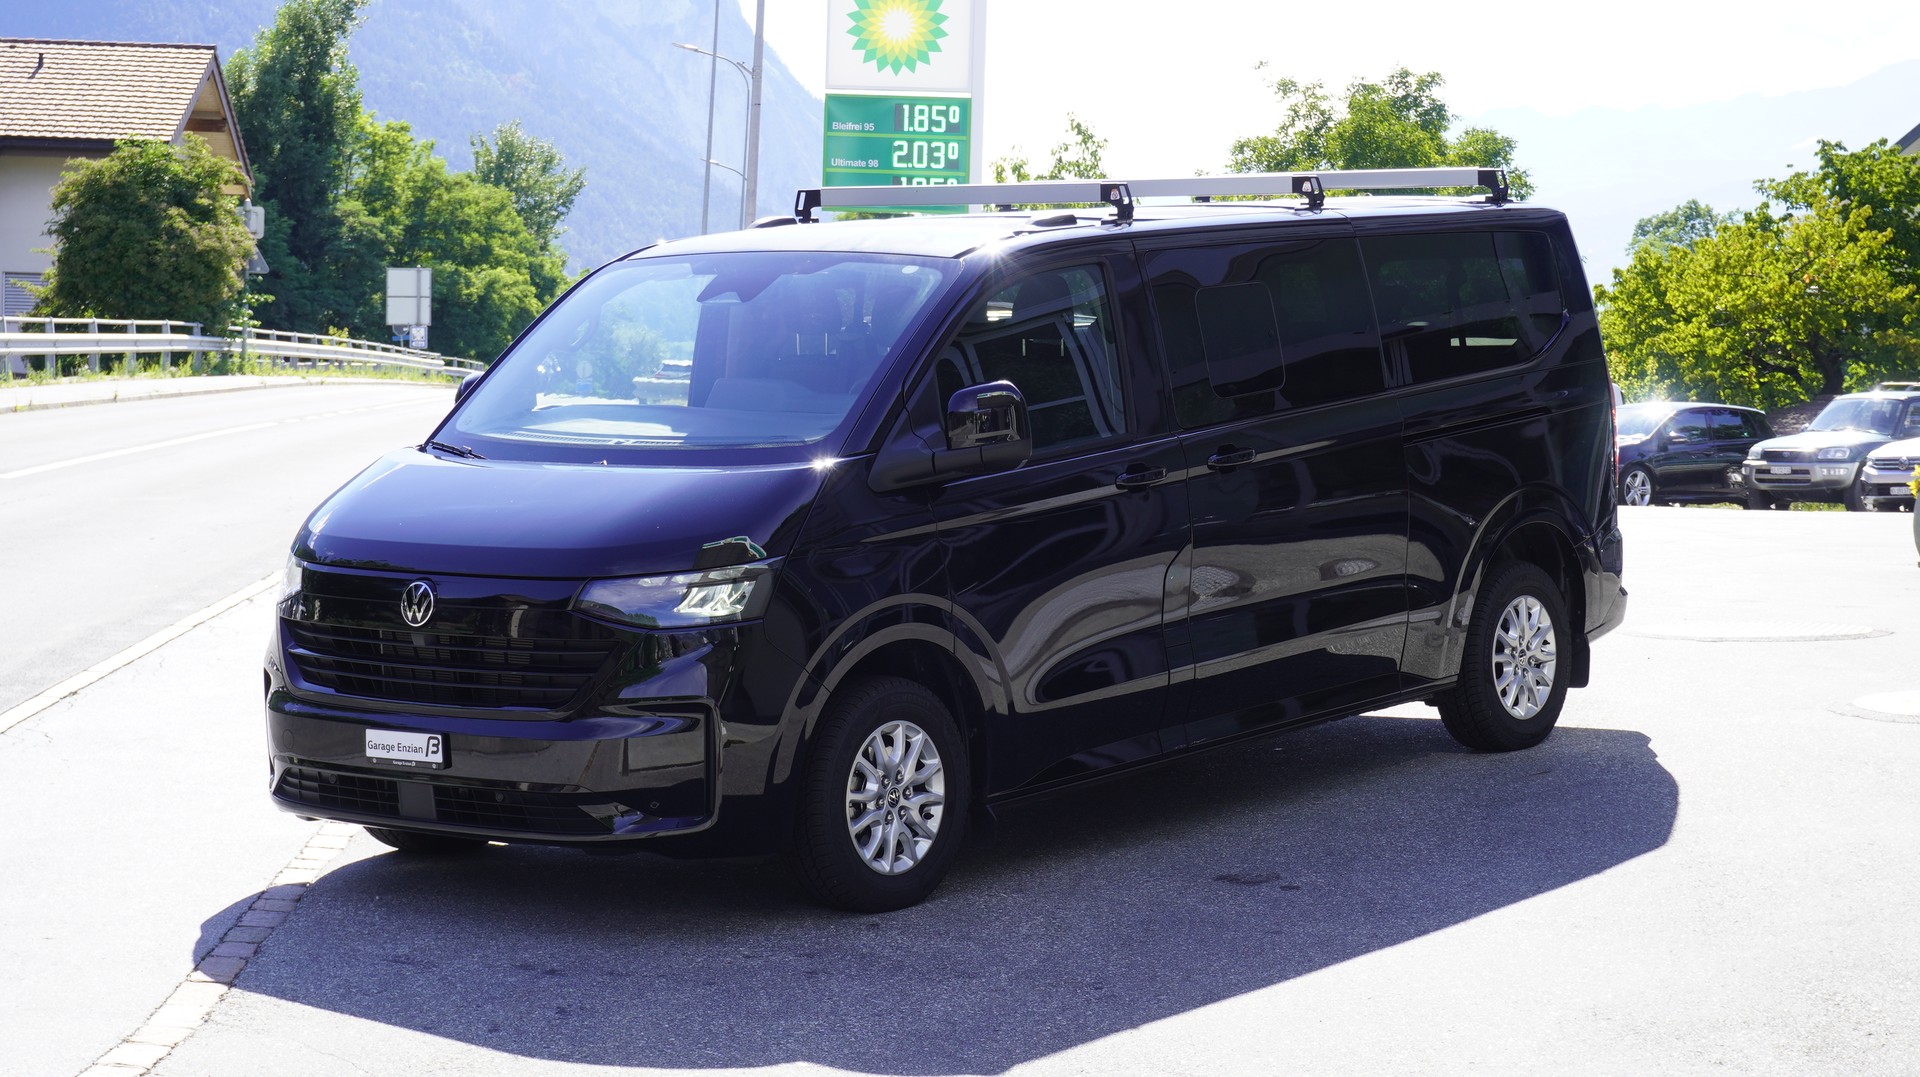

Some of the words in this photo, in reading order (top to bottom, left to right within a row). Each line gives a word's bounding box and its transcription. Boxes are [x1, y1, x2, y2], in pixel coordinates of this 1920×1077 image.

[832, 122, 863, 131] Bleifrei
[864, 123, 875, 131] 95
[831, 158, 866, 167] Ultimate
[867, 159, 879, 168] 98
[367, 740, 396, 754] Garage
[397, 742, 424, 754] Enzian
